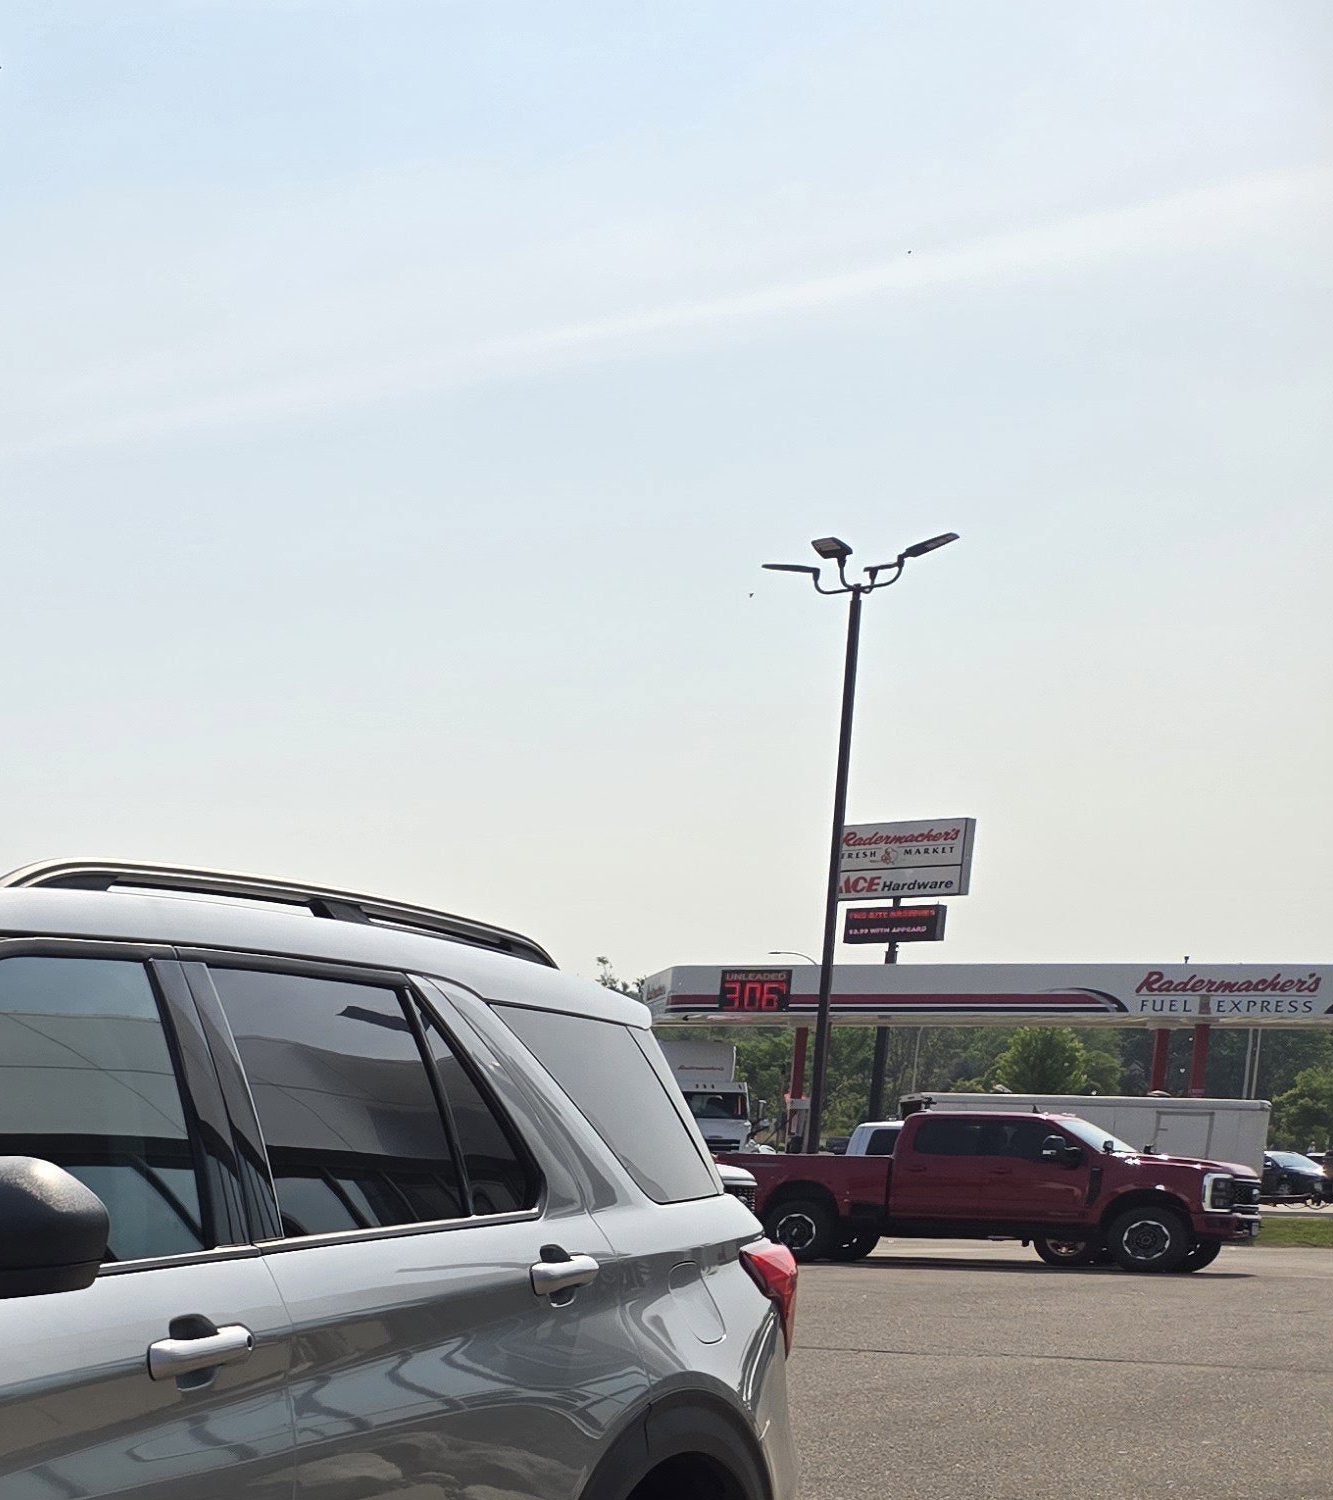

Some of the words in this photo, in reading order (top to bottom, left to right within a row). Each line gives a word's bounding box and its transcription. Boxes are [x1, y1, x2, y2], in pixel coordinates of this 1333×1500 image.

[842, 828, 961, 847] Radermacher's
[903, 846, 955, 855] MARKET
[838, 875, 882, 893] ACE
[880, 879, 954, 891] Hardware
[726, 972, 786, 980] UNLEADED
[1135, 971, 1322, 994] Radermacher's
[1140, 1000, 1192, 1013] FUEL
[1216, 1000, 1313, 1013] EXPRESS
